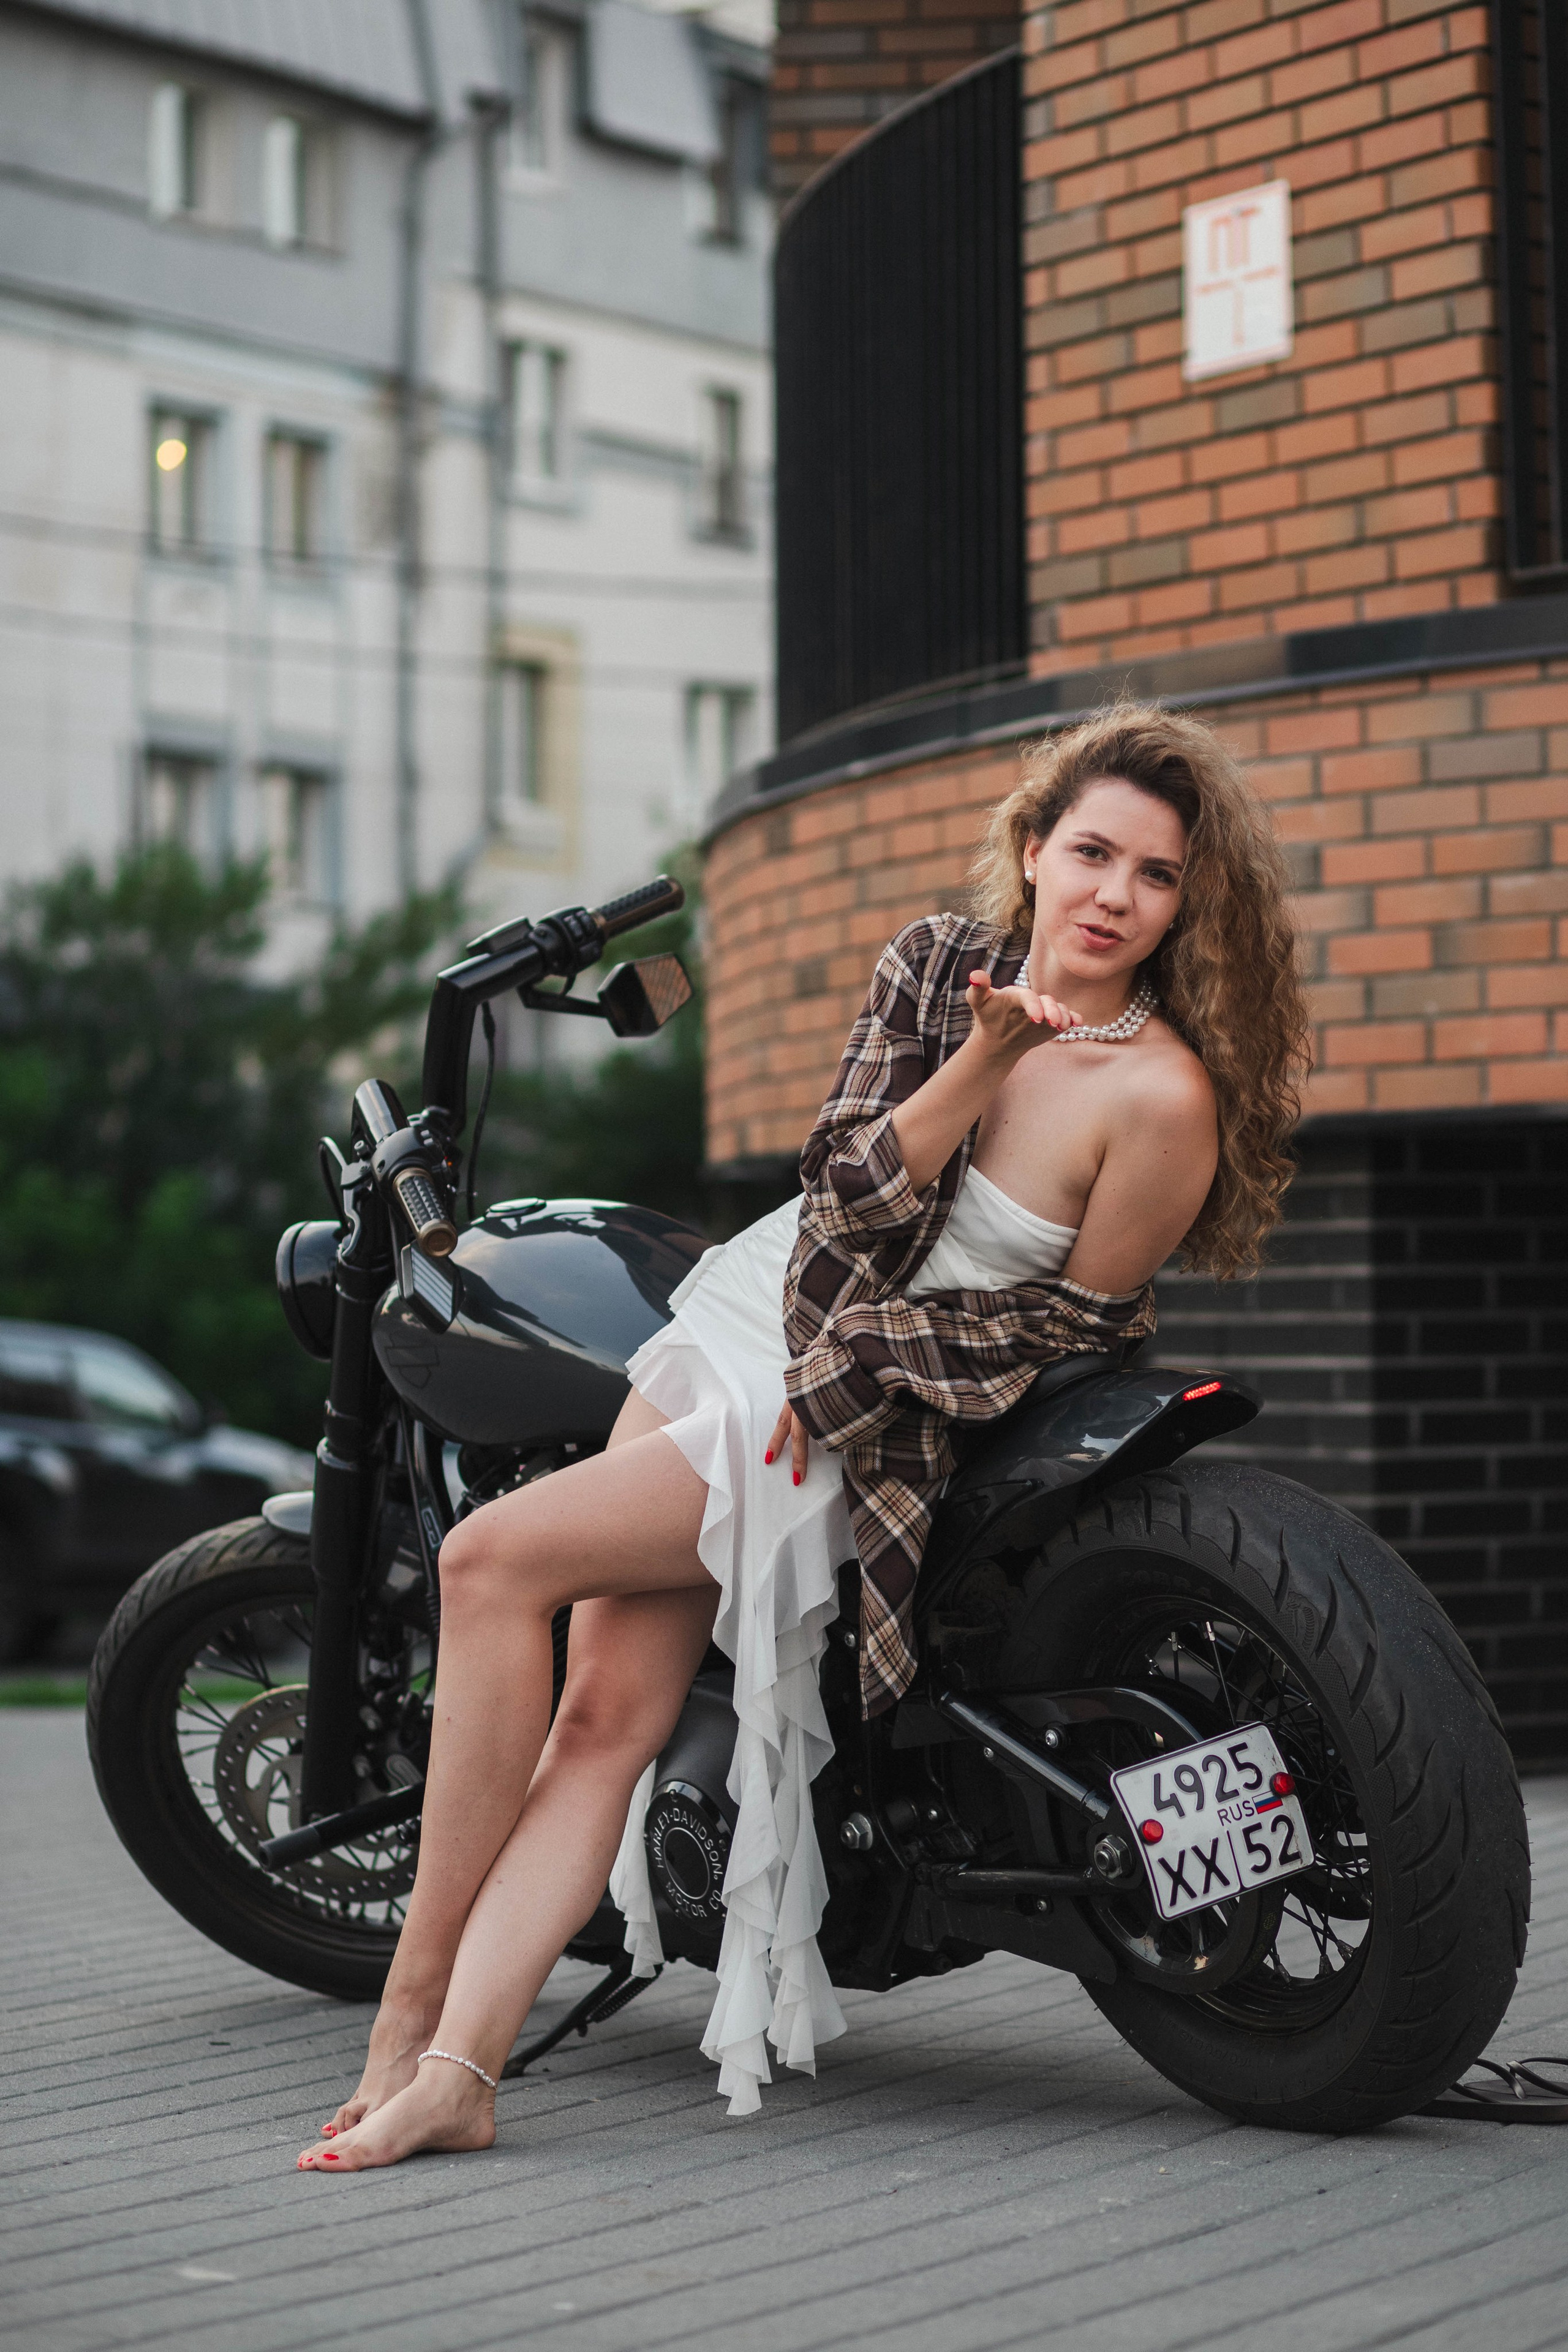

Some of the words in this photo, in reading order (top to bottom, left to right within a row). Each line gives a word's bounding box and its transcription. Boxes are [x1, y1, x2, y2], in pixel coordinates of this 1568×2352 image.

[1153, 1741, 1263, 1818] 4925
[1217, 1800, 1255, 1826] RUS
[1157, 1837, 1231, 1907] XX
[1242, 1814, 1302, 1874] 52
